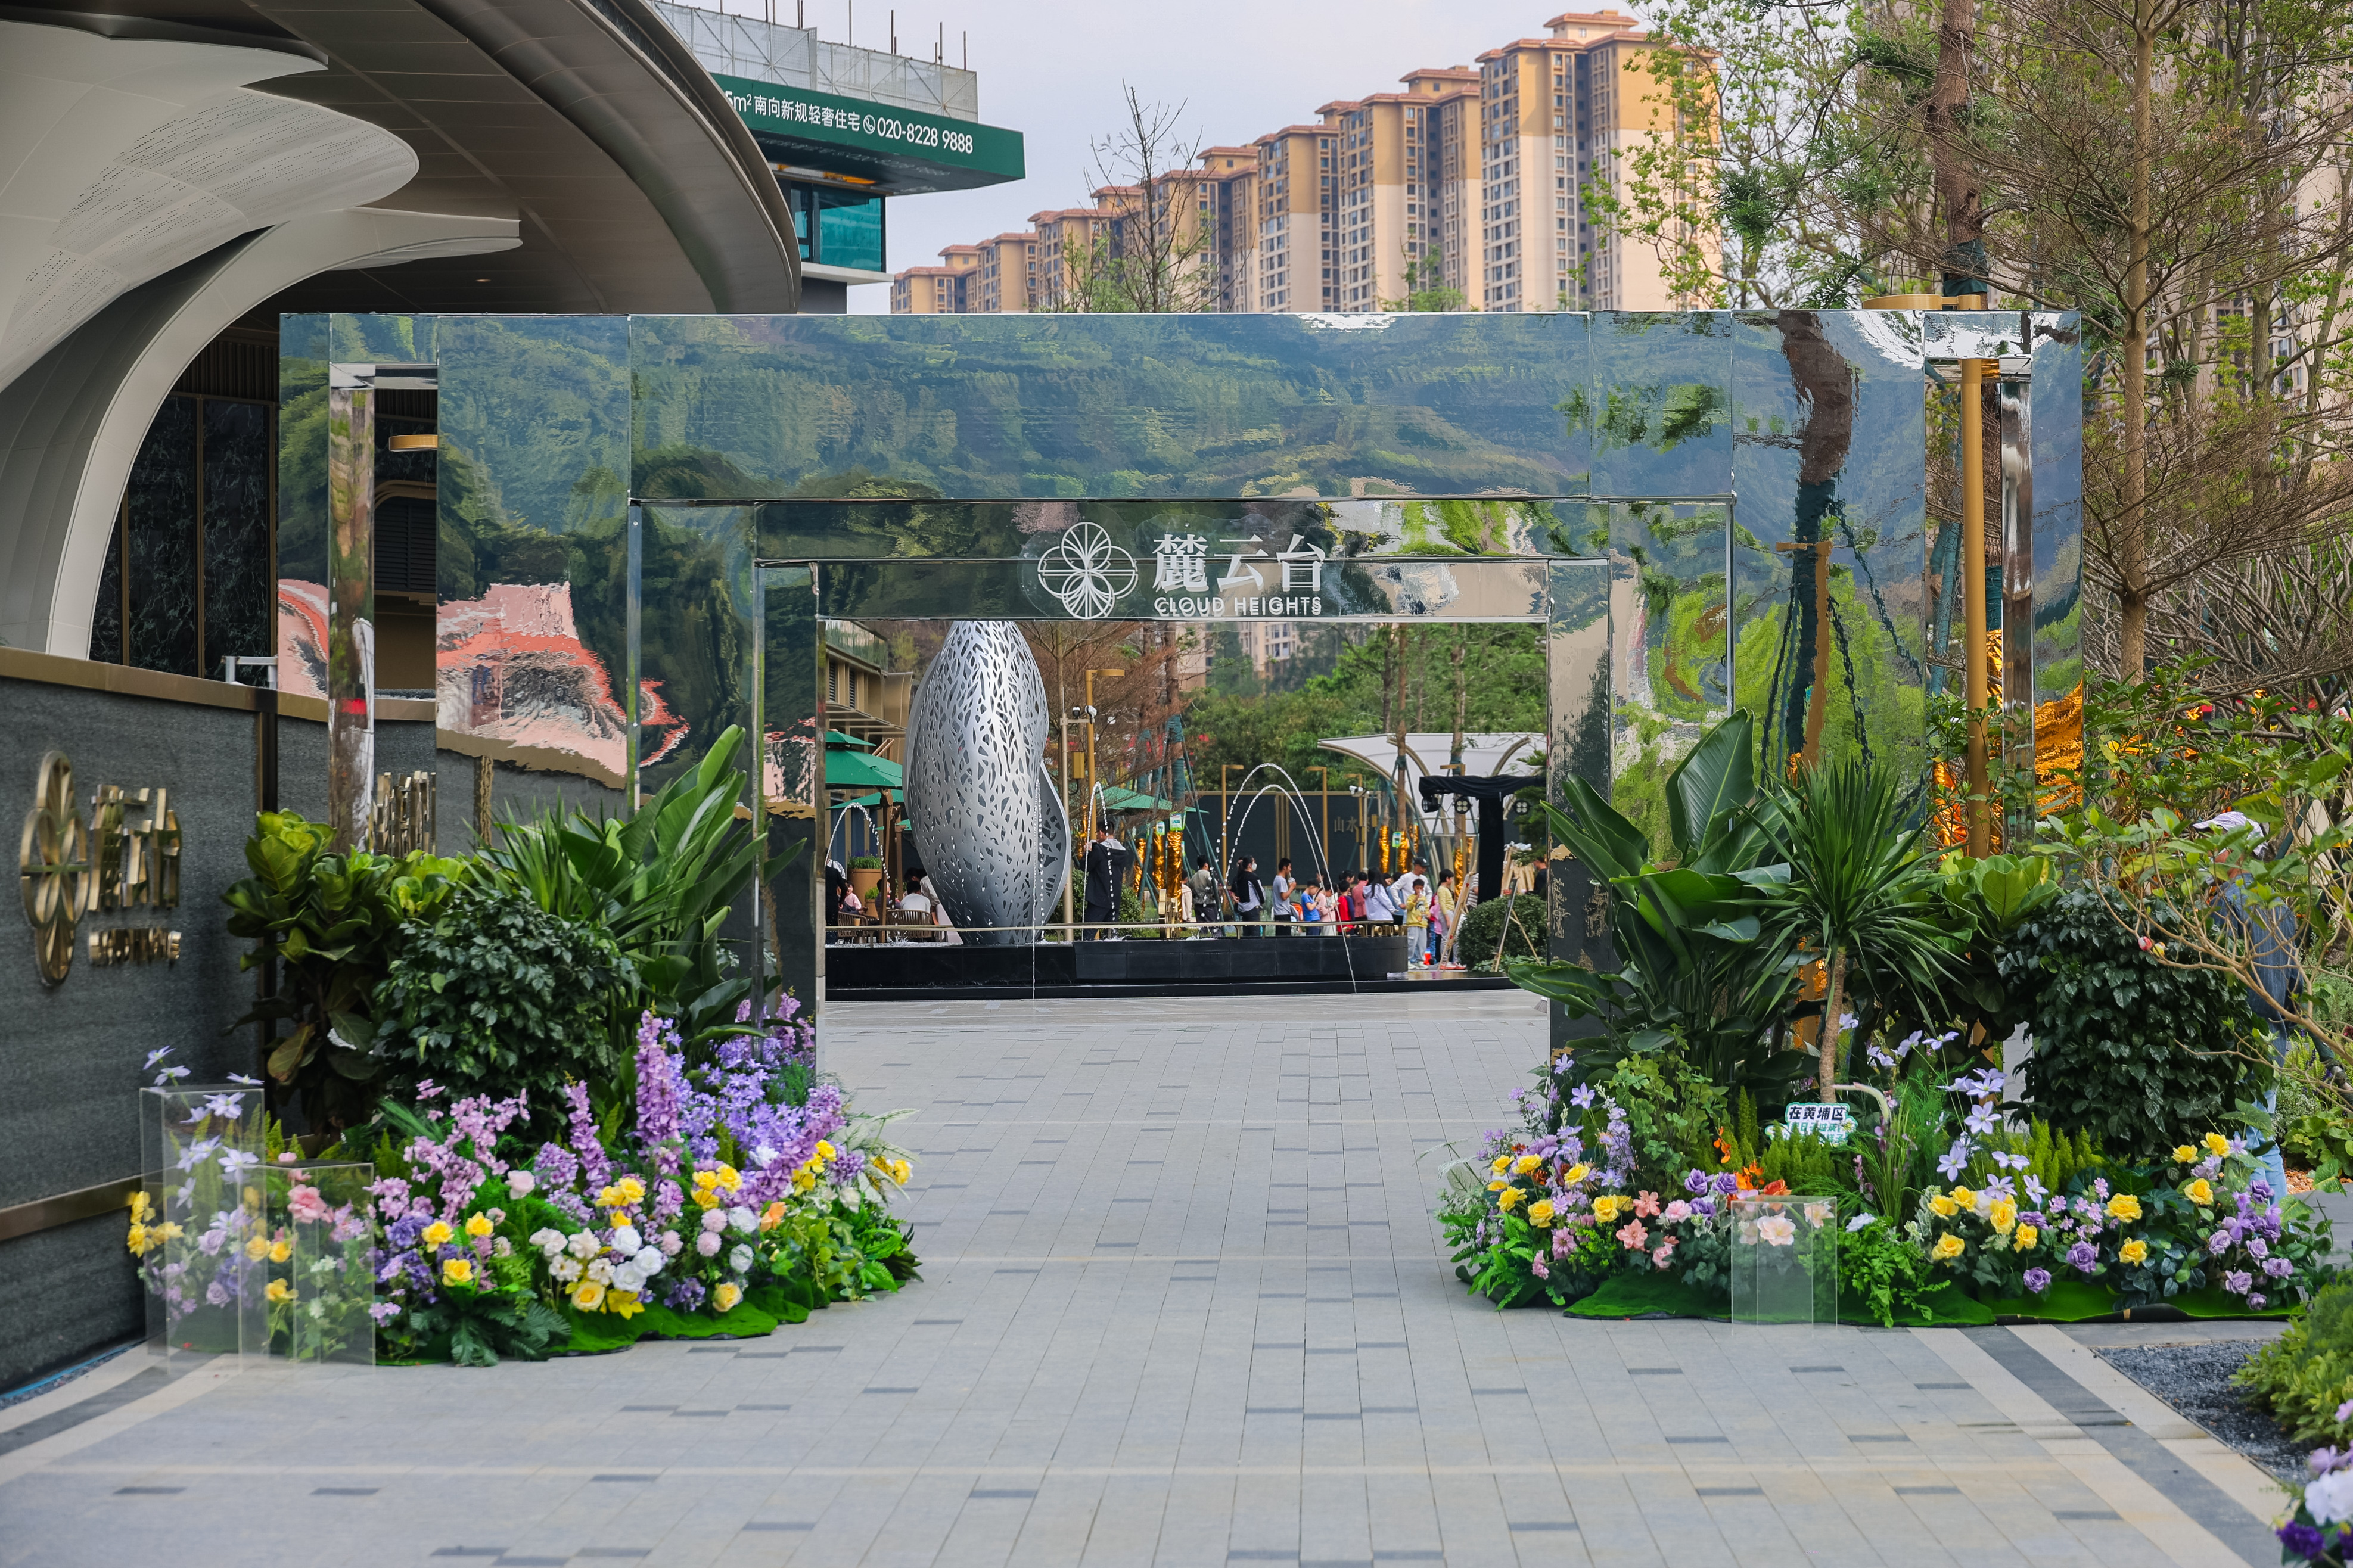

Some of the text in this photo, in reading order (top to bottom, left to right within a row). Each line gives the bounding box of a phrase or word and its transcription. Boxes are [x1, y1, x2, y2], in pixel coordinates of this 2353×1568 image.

[877, 117, 938, 147] 020-8228
[942, 130, 973, 154] 9888
[1152, 534, 1325, 592] 麓云台
[1154, 597, 1322, 616] CLOUD HEIGHTS
[1789, 1106, 1845, 1121] 在黄埔区
